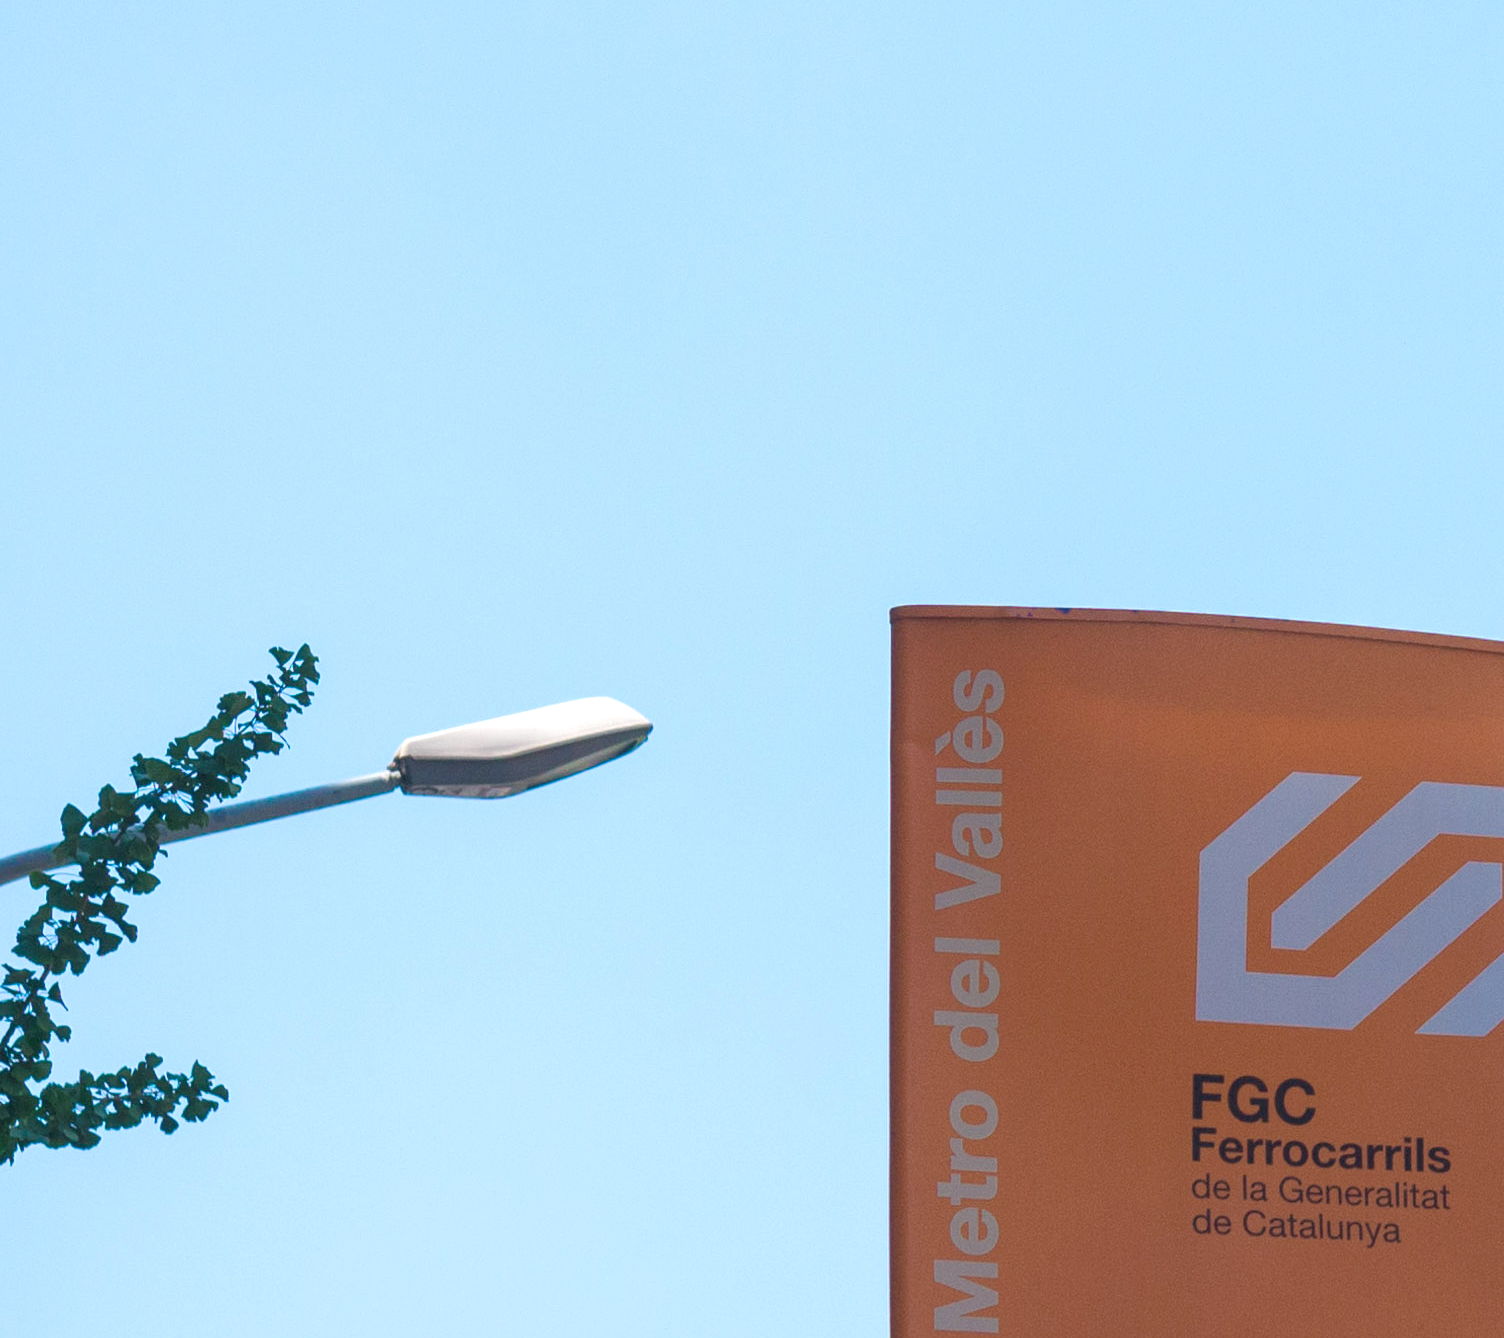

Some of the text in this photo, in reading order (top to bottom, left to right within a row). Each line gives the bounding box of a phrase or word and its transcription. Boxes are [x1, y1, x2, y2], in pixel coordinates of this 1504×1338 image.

[933, 667, 1006, 1335] Metro del Vallès
[1191, 1072, 1317, 1127] FGC
[1191, 1125, 1452, 1175] Ferrocarrils
[1191, 1172, 1451, 1211] de la Generalitat
[1191, 1207, 1402, 1249] de Catalunya
